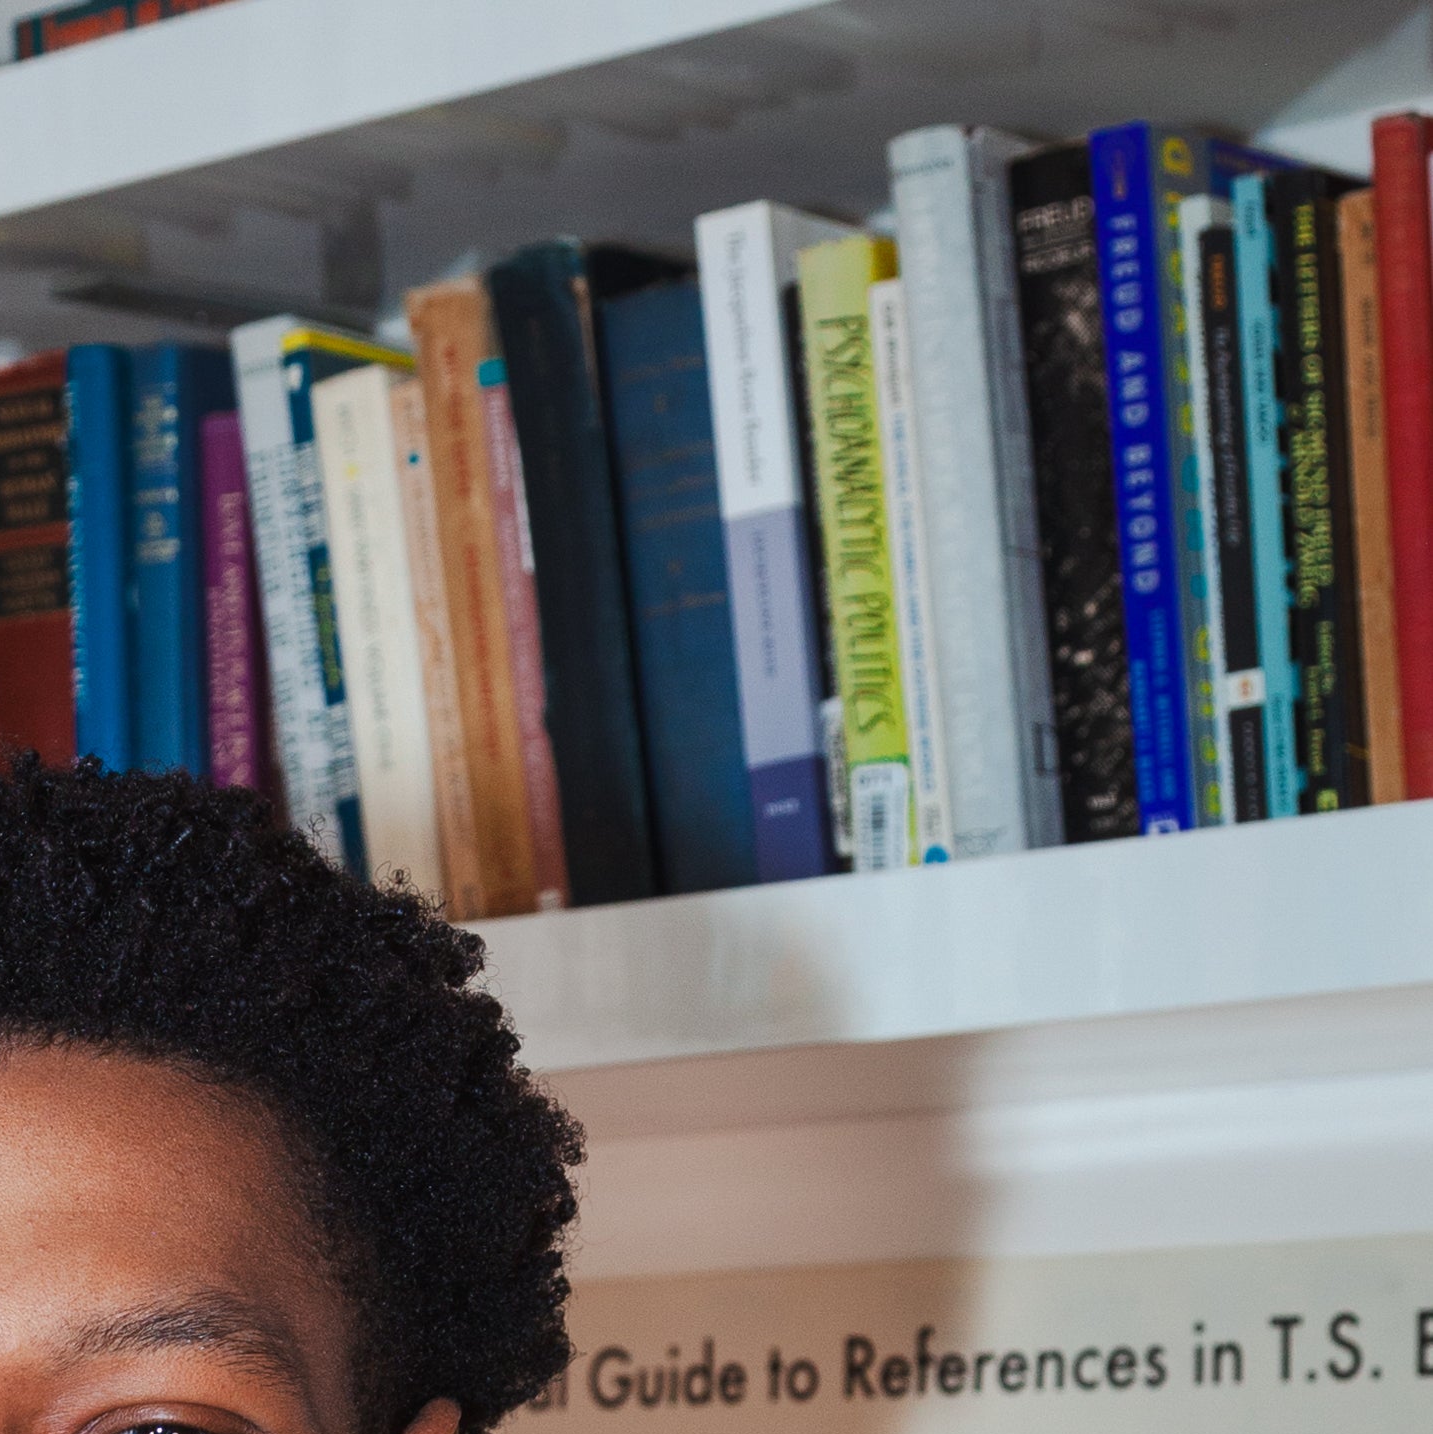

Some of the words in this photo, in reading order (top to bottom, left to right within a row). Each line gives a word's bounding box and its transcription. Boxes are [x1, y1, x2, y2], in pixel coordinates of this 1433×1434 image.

[1108, 213, 1143, 334] FREUD
[817, 314, 885, 580] PSYCHOANALYTIC
[1117, 350, 1150, 429] AND
[1123, 443, 1161, 594] BEYOND
[843, 589, 897, 736] POLITICS
[587, 1335, 749, 1411] Guide
[768, 1346, 822, 1405] to
[842, 1323, 1168, 1400] References
[1193, 1320, 1245, 1387] in
[1269, 1311, 1382, 1384] T.S.
